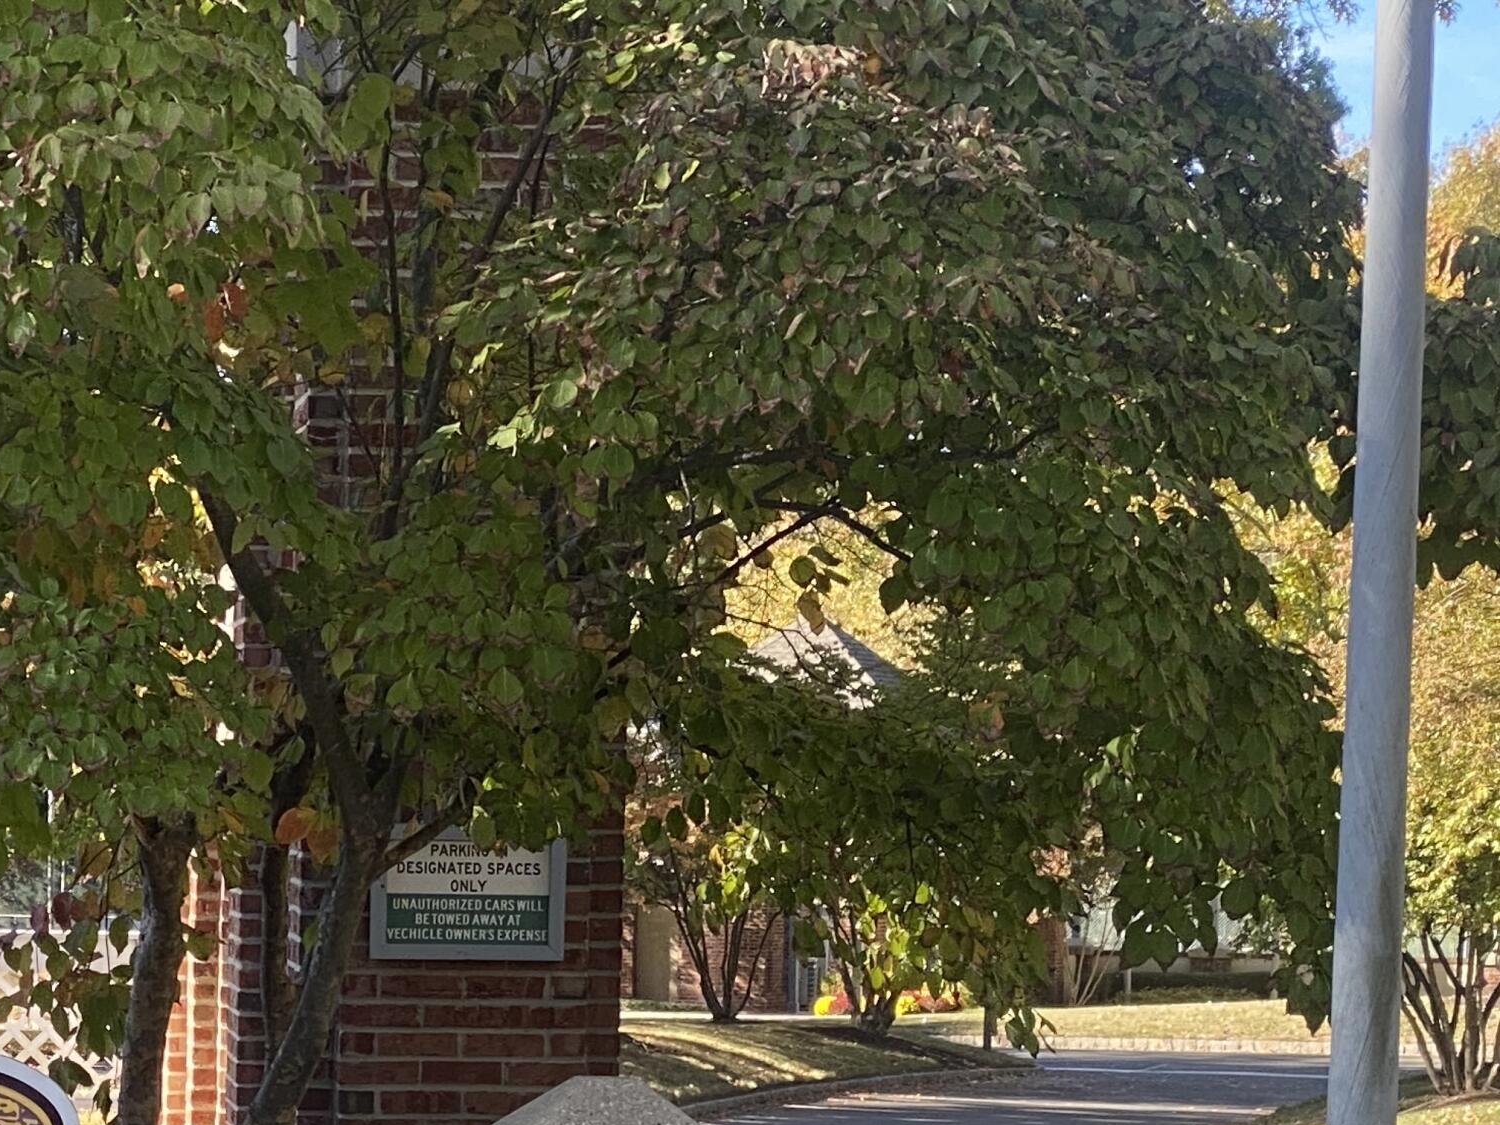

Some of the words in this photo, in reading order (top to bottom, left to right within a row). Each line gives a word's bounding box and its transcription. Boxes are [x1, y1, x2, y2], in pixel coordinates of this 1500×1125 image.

[397, 861, 482, 875] DESIGNATED
[488, 863, 541, 876] SPACES
[450, 880, 488, 893] ONLY
[392, 898, 482, 911] UNAUTHORIZED
[485, 899, 515, 911] CARS
[516, 900, 544, 912] WILL
[415, 913, 431, 925] BE
[432, 914, 470, 926] TOWED
[471, 914, 506, 926] AWAY
[506, 915, 521, 926] AT
[387, 928, 445, 940] VECHICLE
[497, 929, 548, 942] EXPENSE
